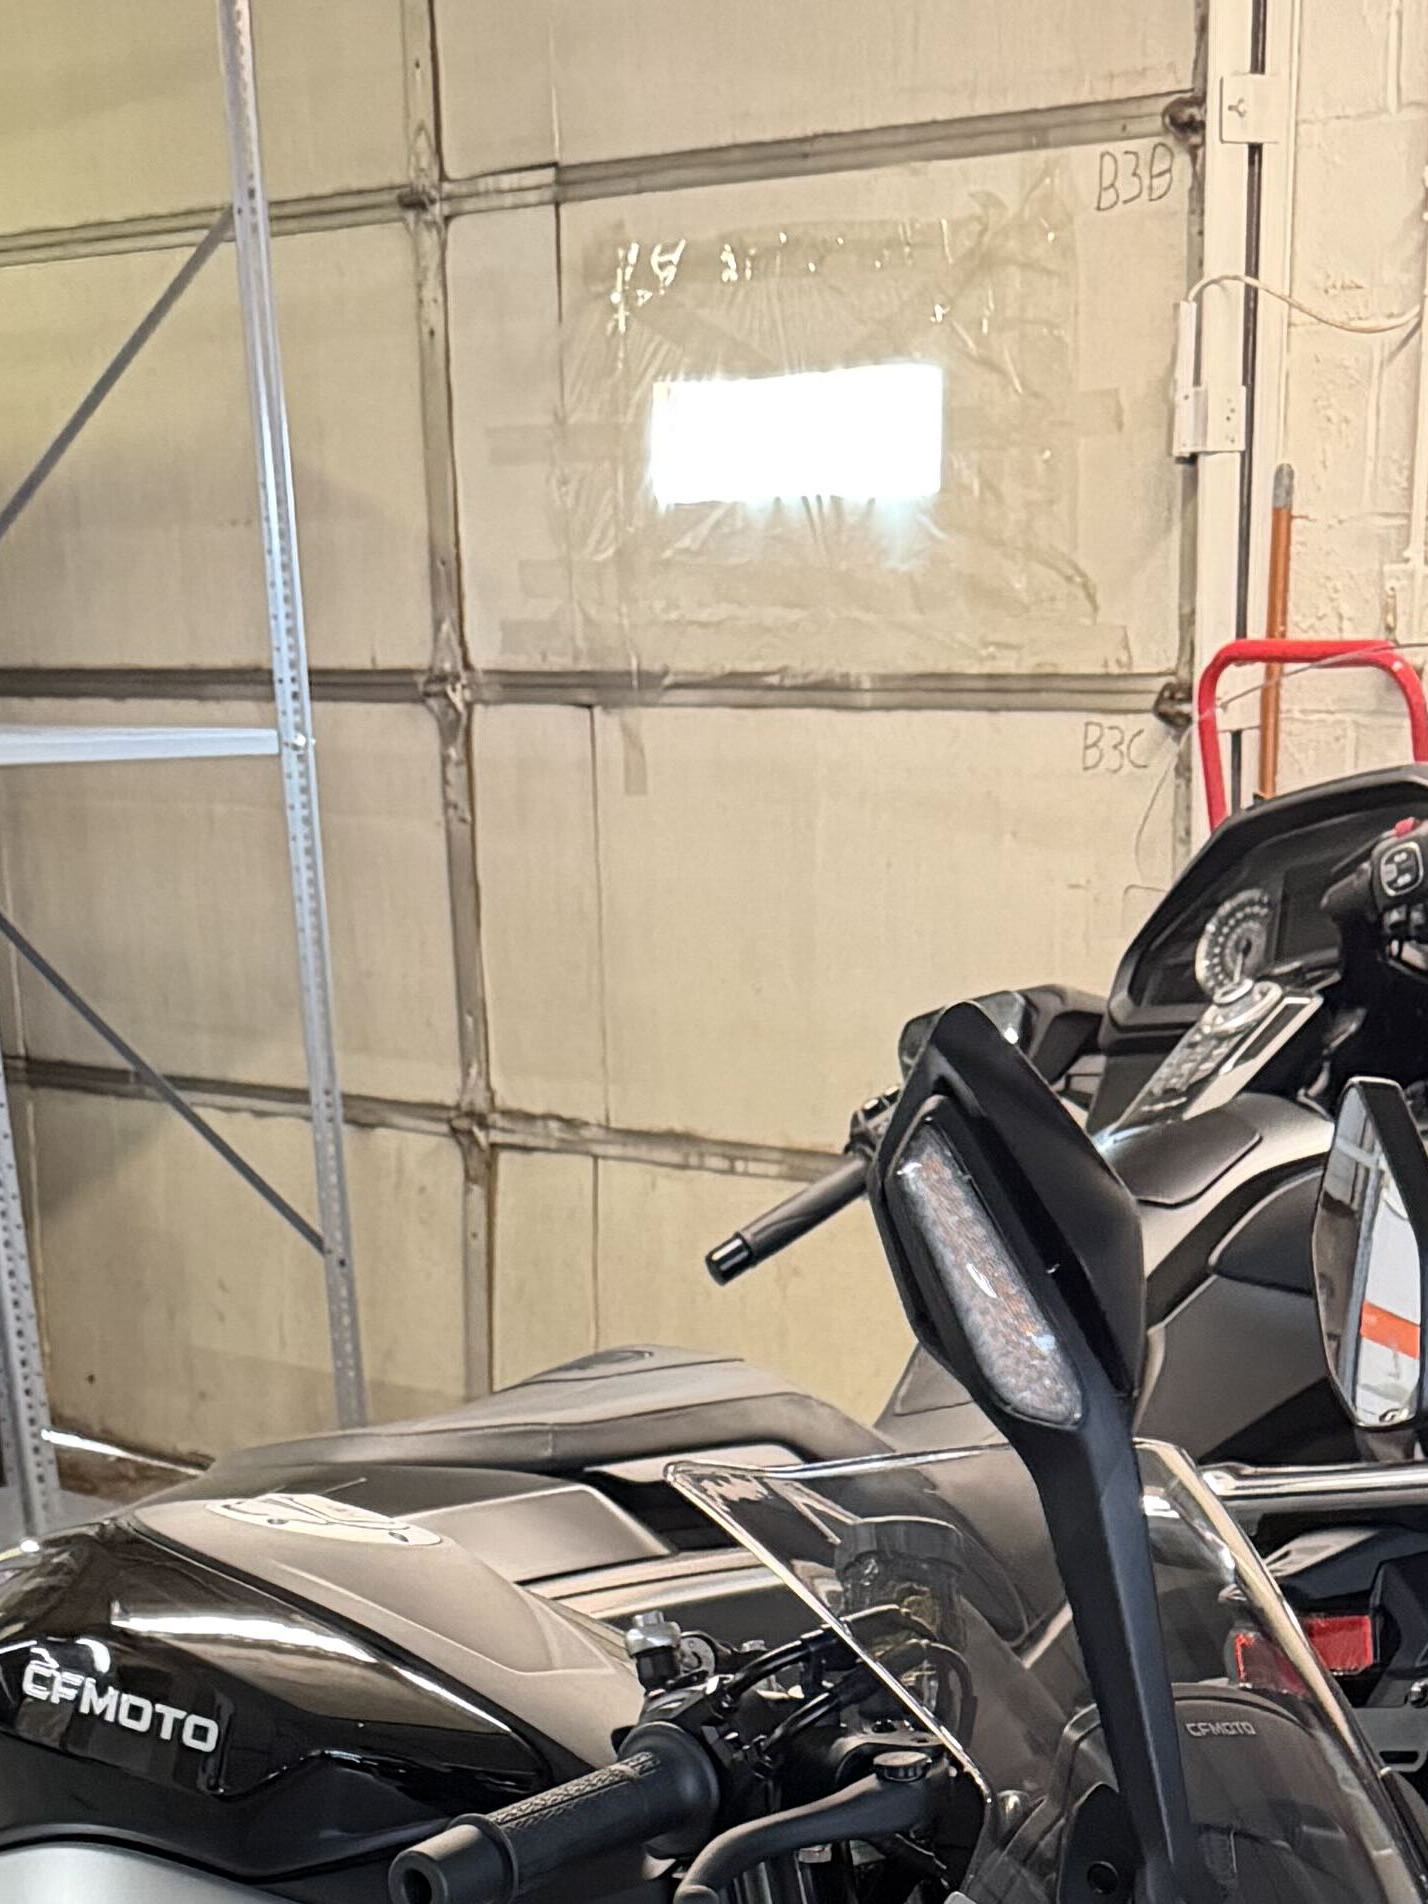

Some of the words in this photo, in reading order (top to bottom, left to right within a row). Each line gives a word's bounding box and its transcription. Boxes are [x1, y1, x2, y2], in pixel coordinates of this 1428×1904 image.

[1096, 142, 1175, 212] B3B
[1082, 720, 1149, 775] B3C
[23, 1659, 219, 1753] CFMOTO
[1185, 1721, 1256, 1737] CFMOTO
